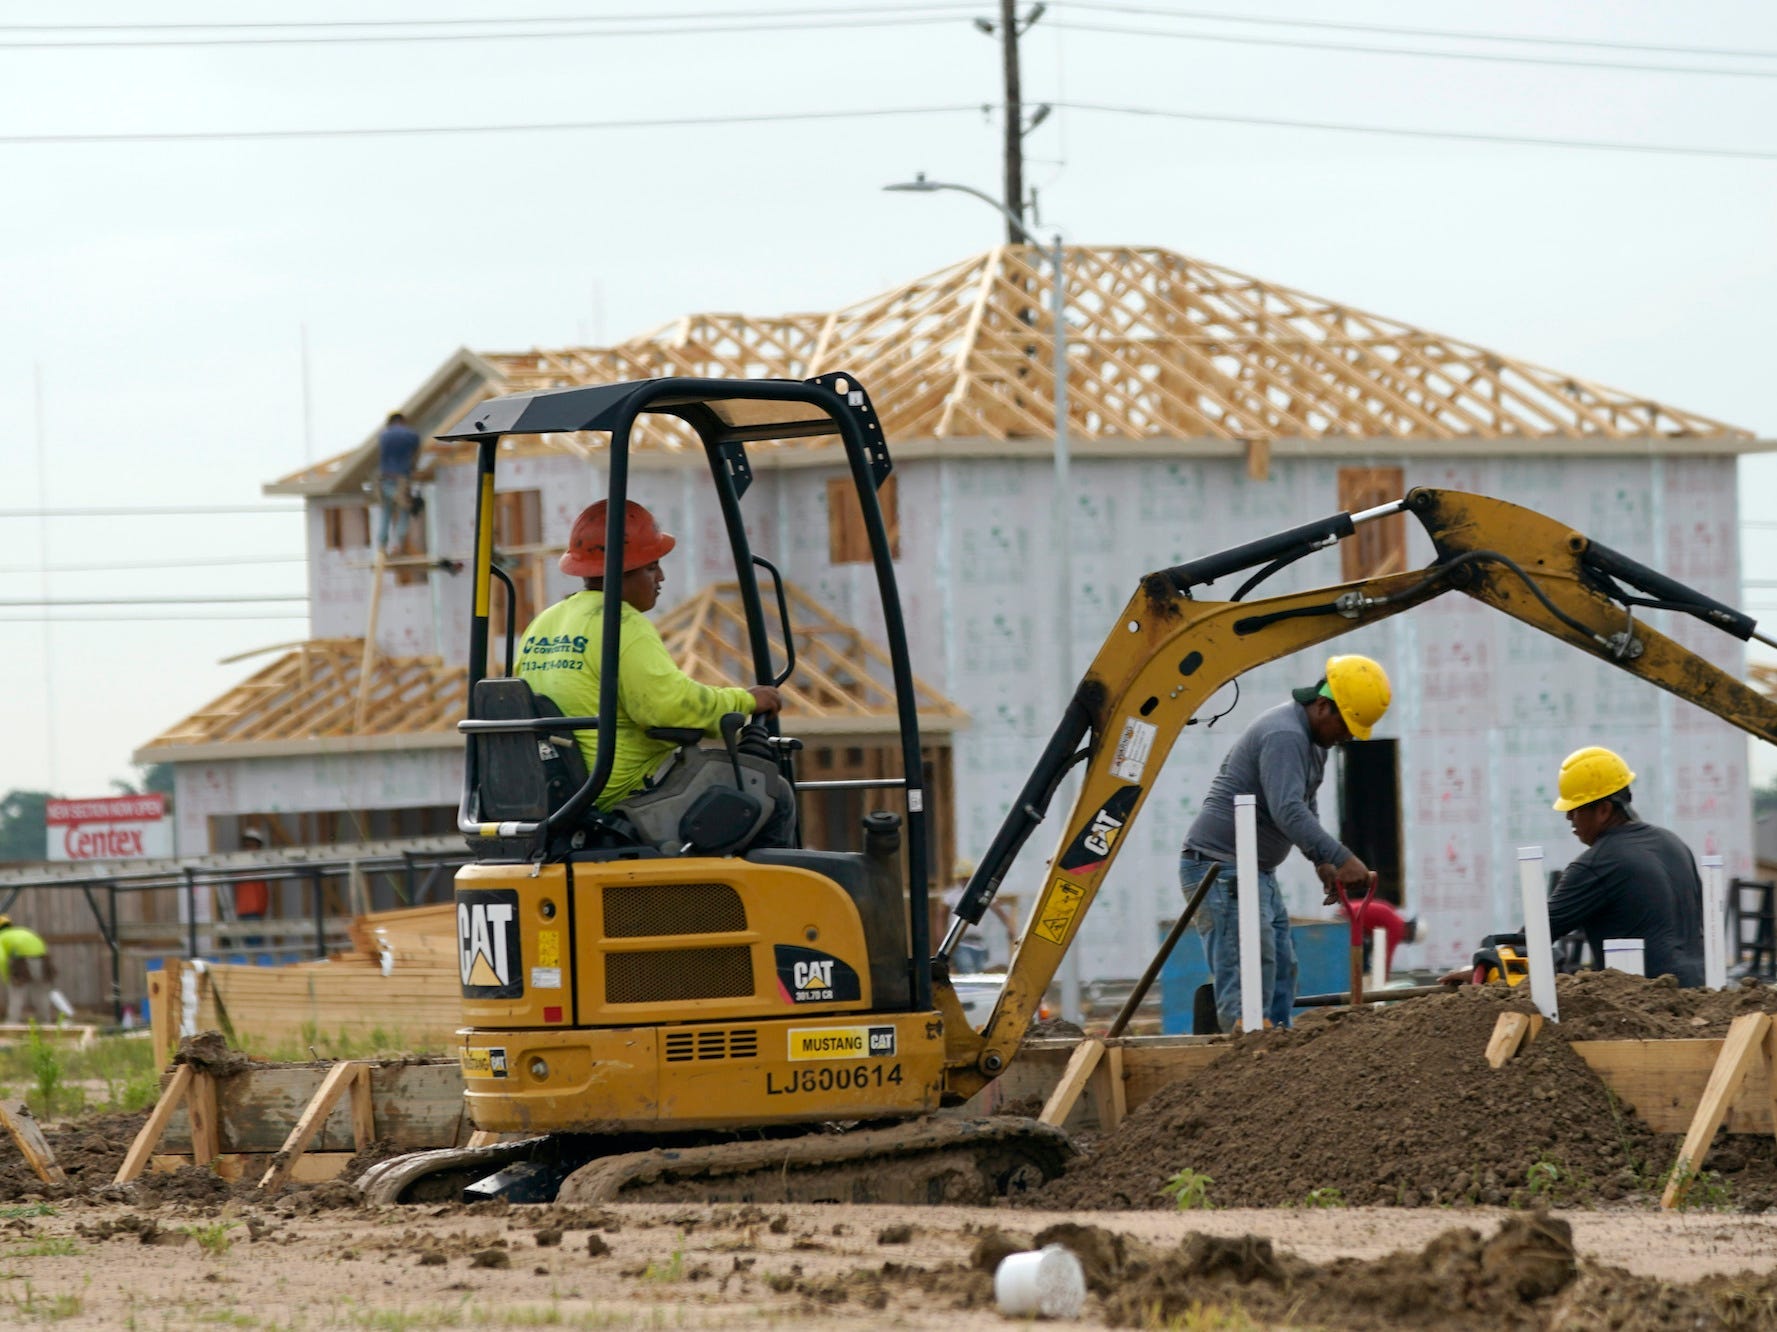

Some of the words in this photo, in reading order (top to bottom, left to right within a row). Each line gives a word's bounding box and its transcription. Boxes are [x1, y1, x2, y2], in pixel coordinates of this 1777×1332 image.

[523, 634, 588, 654] CASAS
[64, 824, 143, 859] Centex
[1084, 809, 1123, 856] CAT
[458, 903, 513, 986] CAT
[793, 960, 834, 989] CAT
[803, 1037, 862, 1052] MUSTANG
[870, 1034, 893, 1050] CAT
[767, 1064, 903, 1095] LJ800614
